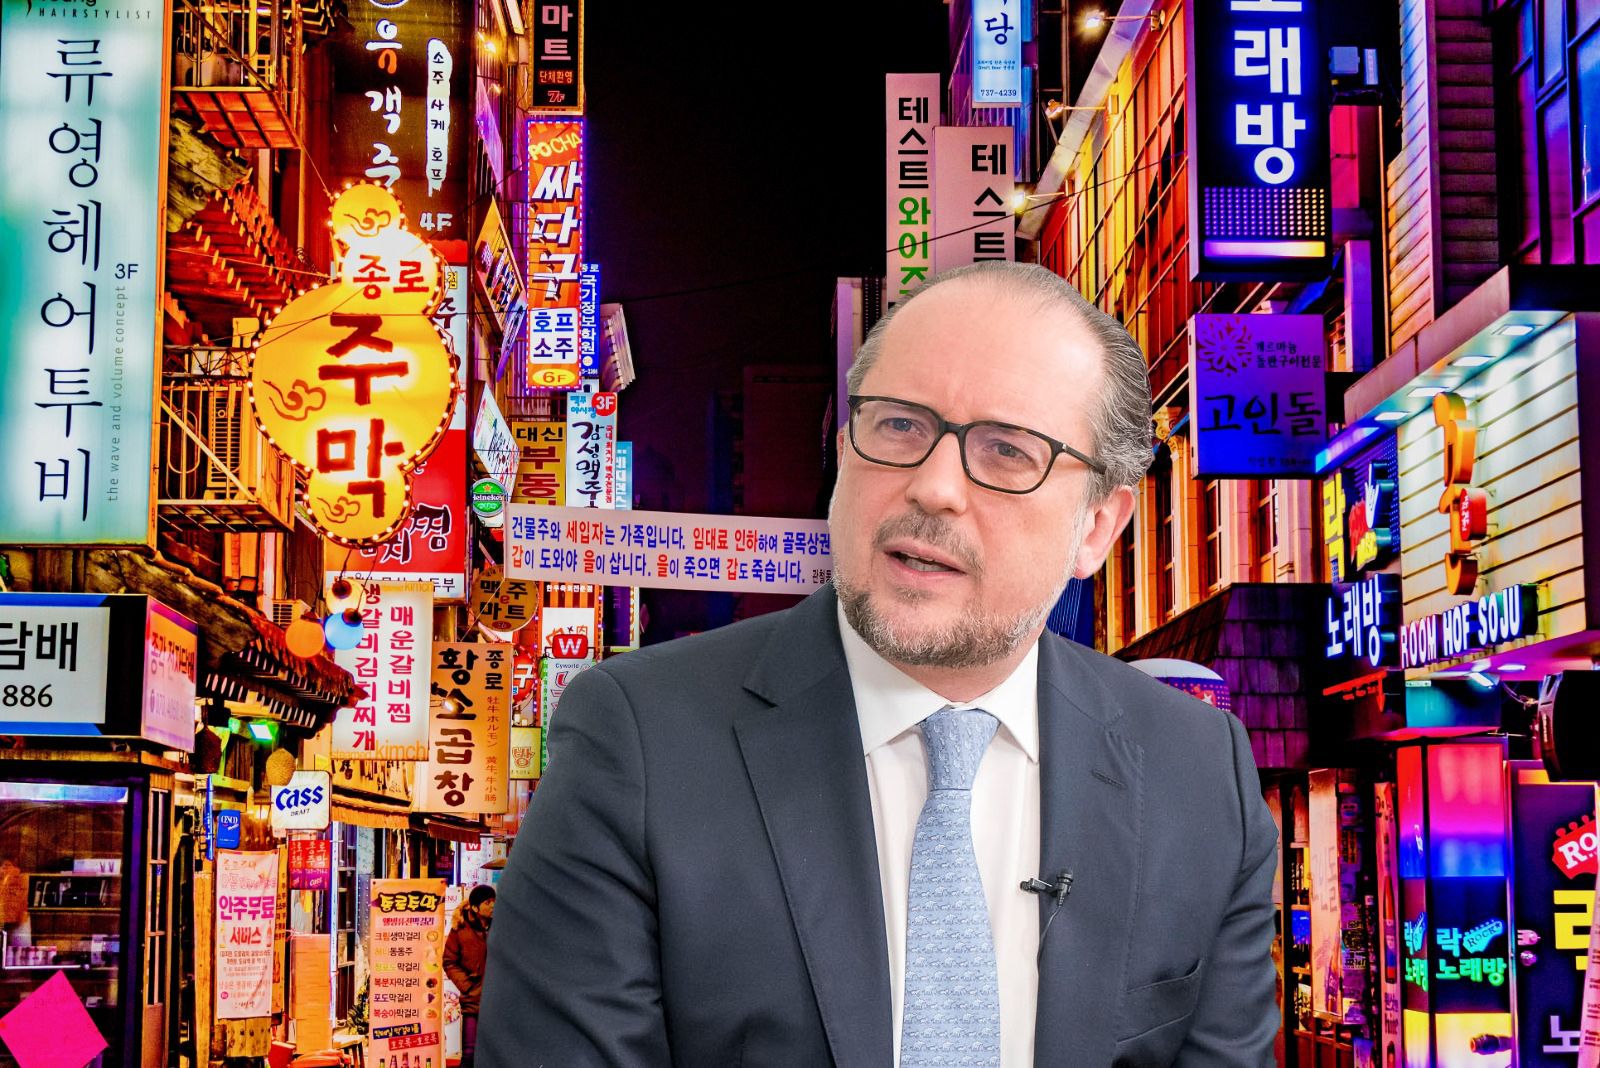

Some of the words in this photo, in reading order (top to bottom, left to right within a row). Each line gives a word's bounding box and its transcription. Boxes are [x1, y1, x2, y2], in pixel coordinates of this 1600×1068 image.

[39, 7, 151, 19] HAIRSTYLIST
[984, 0, 1014, 46] 당
[433, 52, 445, 84] 소주
[539, 70, 574, 84] 단체환영
[1231, 0, 1306, 185] 래방
[431, 99, 445, 132] 사케
[529, 131, 582, 161] POCHA
[431, 147, 443, 181] 호프
[419, 212, 453, 231] 4F
[530, 160, 582, 301] 싸다구
[114, 263, 139, 280] 3F
[353, 254, 430, 300] 종로
[115, 286, 129, 343] concept
[533, 311, 574, 333] 호프
[533, 337, 574, 360] 소주
[114, 346, 125, 399] volume
[542, 371, 567, 384] 6F
[112, 404, 122, 431] and
[317, 312, 410, 519] 주막
[596, 395, 615, 410] 3F
[1200, 392, 1322, 437] 고인돌
[516, 427, 564, 443] 대신
[110, 433, 121, 474] wave
[517, 445, 561, 505] 부동
[107, 483, 118, 501] the
[512, 516, 561, 543] 건물주와
[566, 520, 615, 546] 세입자는
[620, 523, 685, 551] 가족입니다.
[693, 527, 728, 551] 임대료
[734, 528, 778, 554] 인하하여
[512, 545, 534, 569] 갑이
[539, 548, 578, 572] 도와야
[583, 550, 605, 574] 을이
[609, 552, 651, 577] 삽니다.
[657, 553, 679, 578] 을이
[683, 556, 721, 580] 죽으면
[726, 558, 749, 581] 갑도
[751, 558, 805, 584] 죽습니다.
[480, 580, 528, 600] 맥주
[480, 601, 527, 621] 마트
[1326, 573, 1383, 667] 노래방
[1401, 614, 1438, 669] ROOM
[1443, 603, 1472, 657] HOF
[1478, 584, 1522, 646] SOJU
[484, 650, 505, 691] 종로
[219, 895, 275, 921] 안주무료
[229, 926, 262, 945] 서비스
[1436, 927, 1463, 958] 락
[1467, 925, 1497, 948] ROCK
[1435, 957, 1508, 987] 노래방
